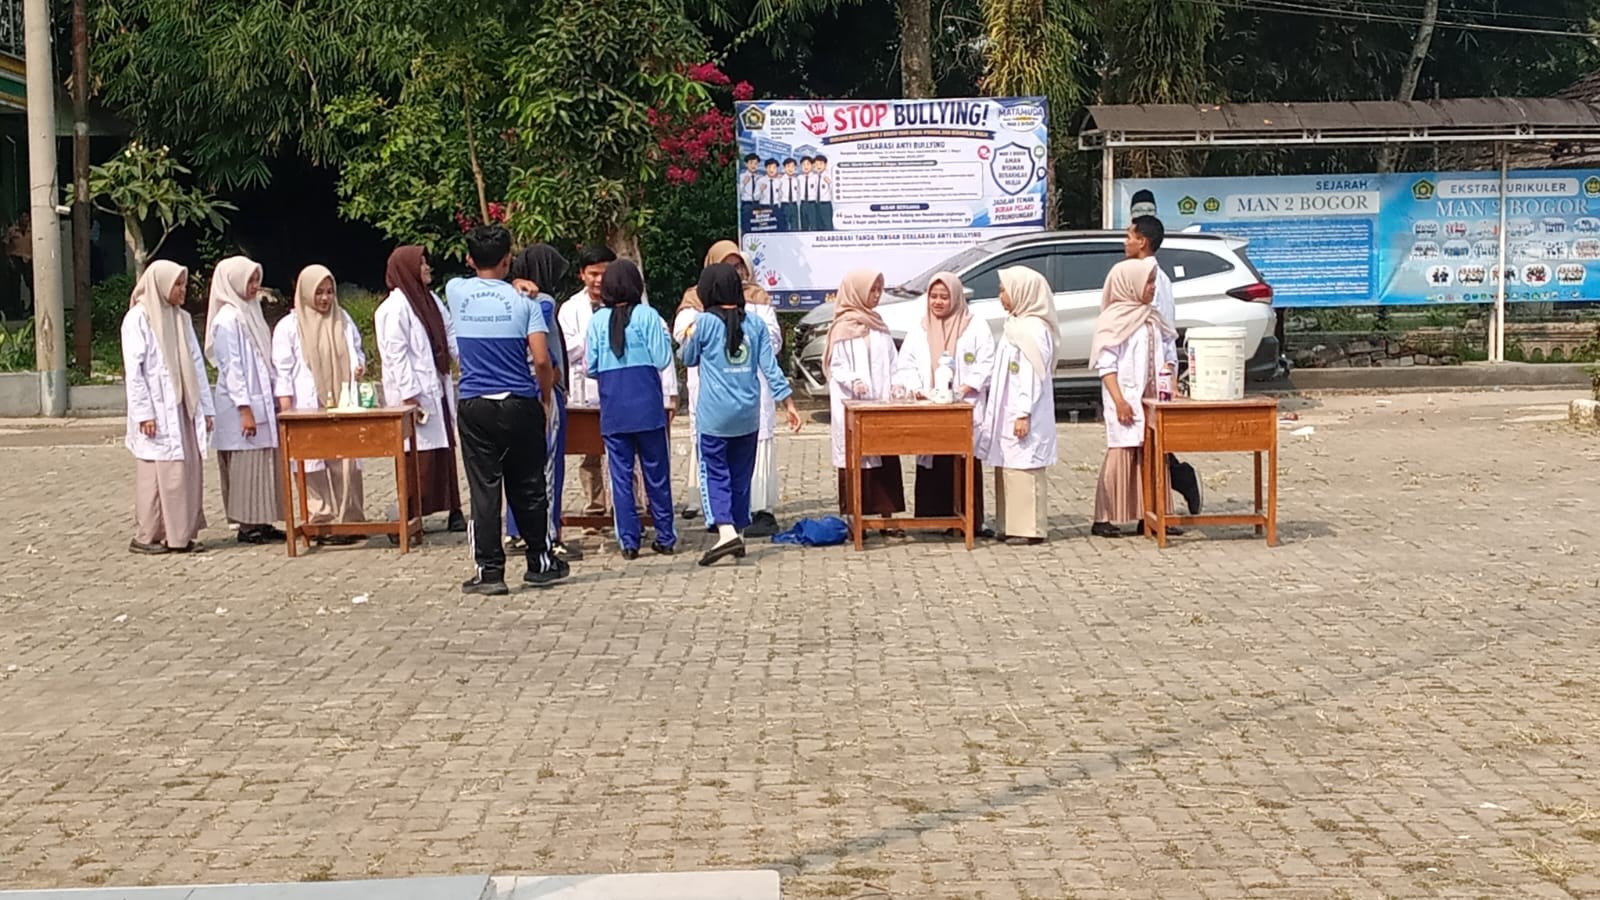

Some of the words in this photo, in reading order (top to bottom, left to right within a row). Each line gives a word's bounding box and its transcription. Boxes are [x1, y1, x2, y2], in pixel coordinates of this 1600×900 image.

[770, 109, 788, 117] MAN
[789, 109, 795, 117] 2
[833, 103, 888, 132] STOP
[894, 101, 989, 127] BULLYING!
[770, 118, 796, 126] BOGOR
[811, 122, 828, 131] STOP
[857, 142, 894, 150] DEKLARASI
[913, 141, 945, 149] BULLYING
[1315, 180, 1368, 191] SEJARAH
[1450, 183, 1567, 194] EKSTRAURIKULER
[1237, 197, 1280, 212] MAN
[1285, 198, 1294, 211] 2
[1300, 195, 1369, 211] BOGOR
[1436, 200, 1487, 217] MAN
[1510, 198, 1590, 216] BOGOR
